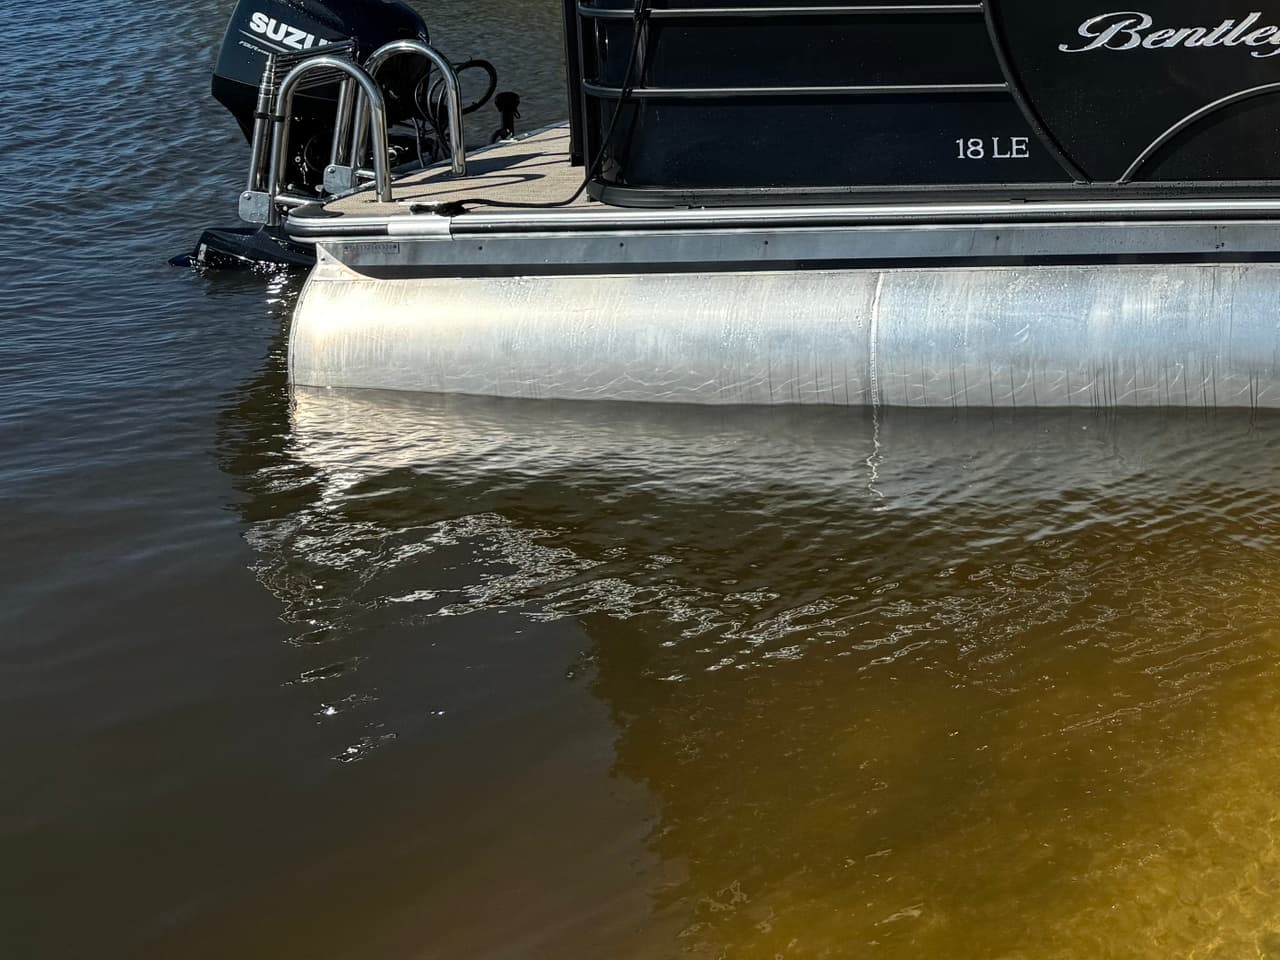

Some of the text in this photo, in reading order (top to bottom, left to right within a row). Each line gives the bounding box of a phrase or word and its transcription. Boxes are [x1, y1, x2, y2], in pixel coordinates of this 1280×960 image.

[249, 12, 332, 50] SUZU
[955, 137, 1030, 160] 18 LE
